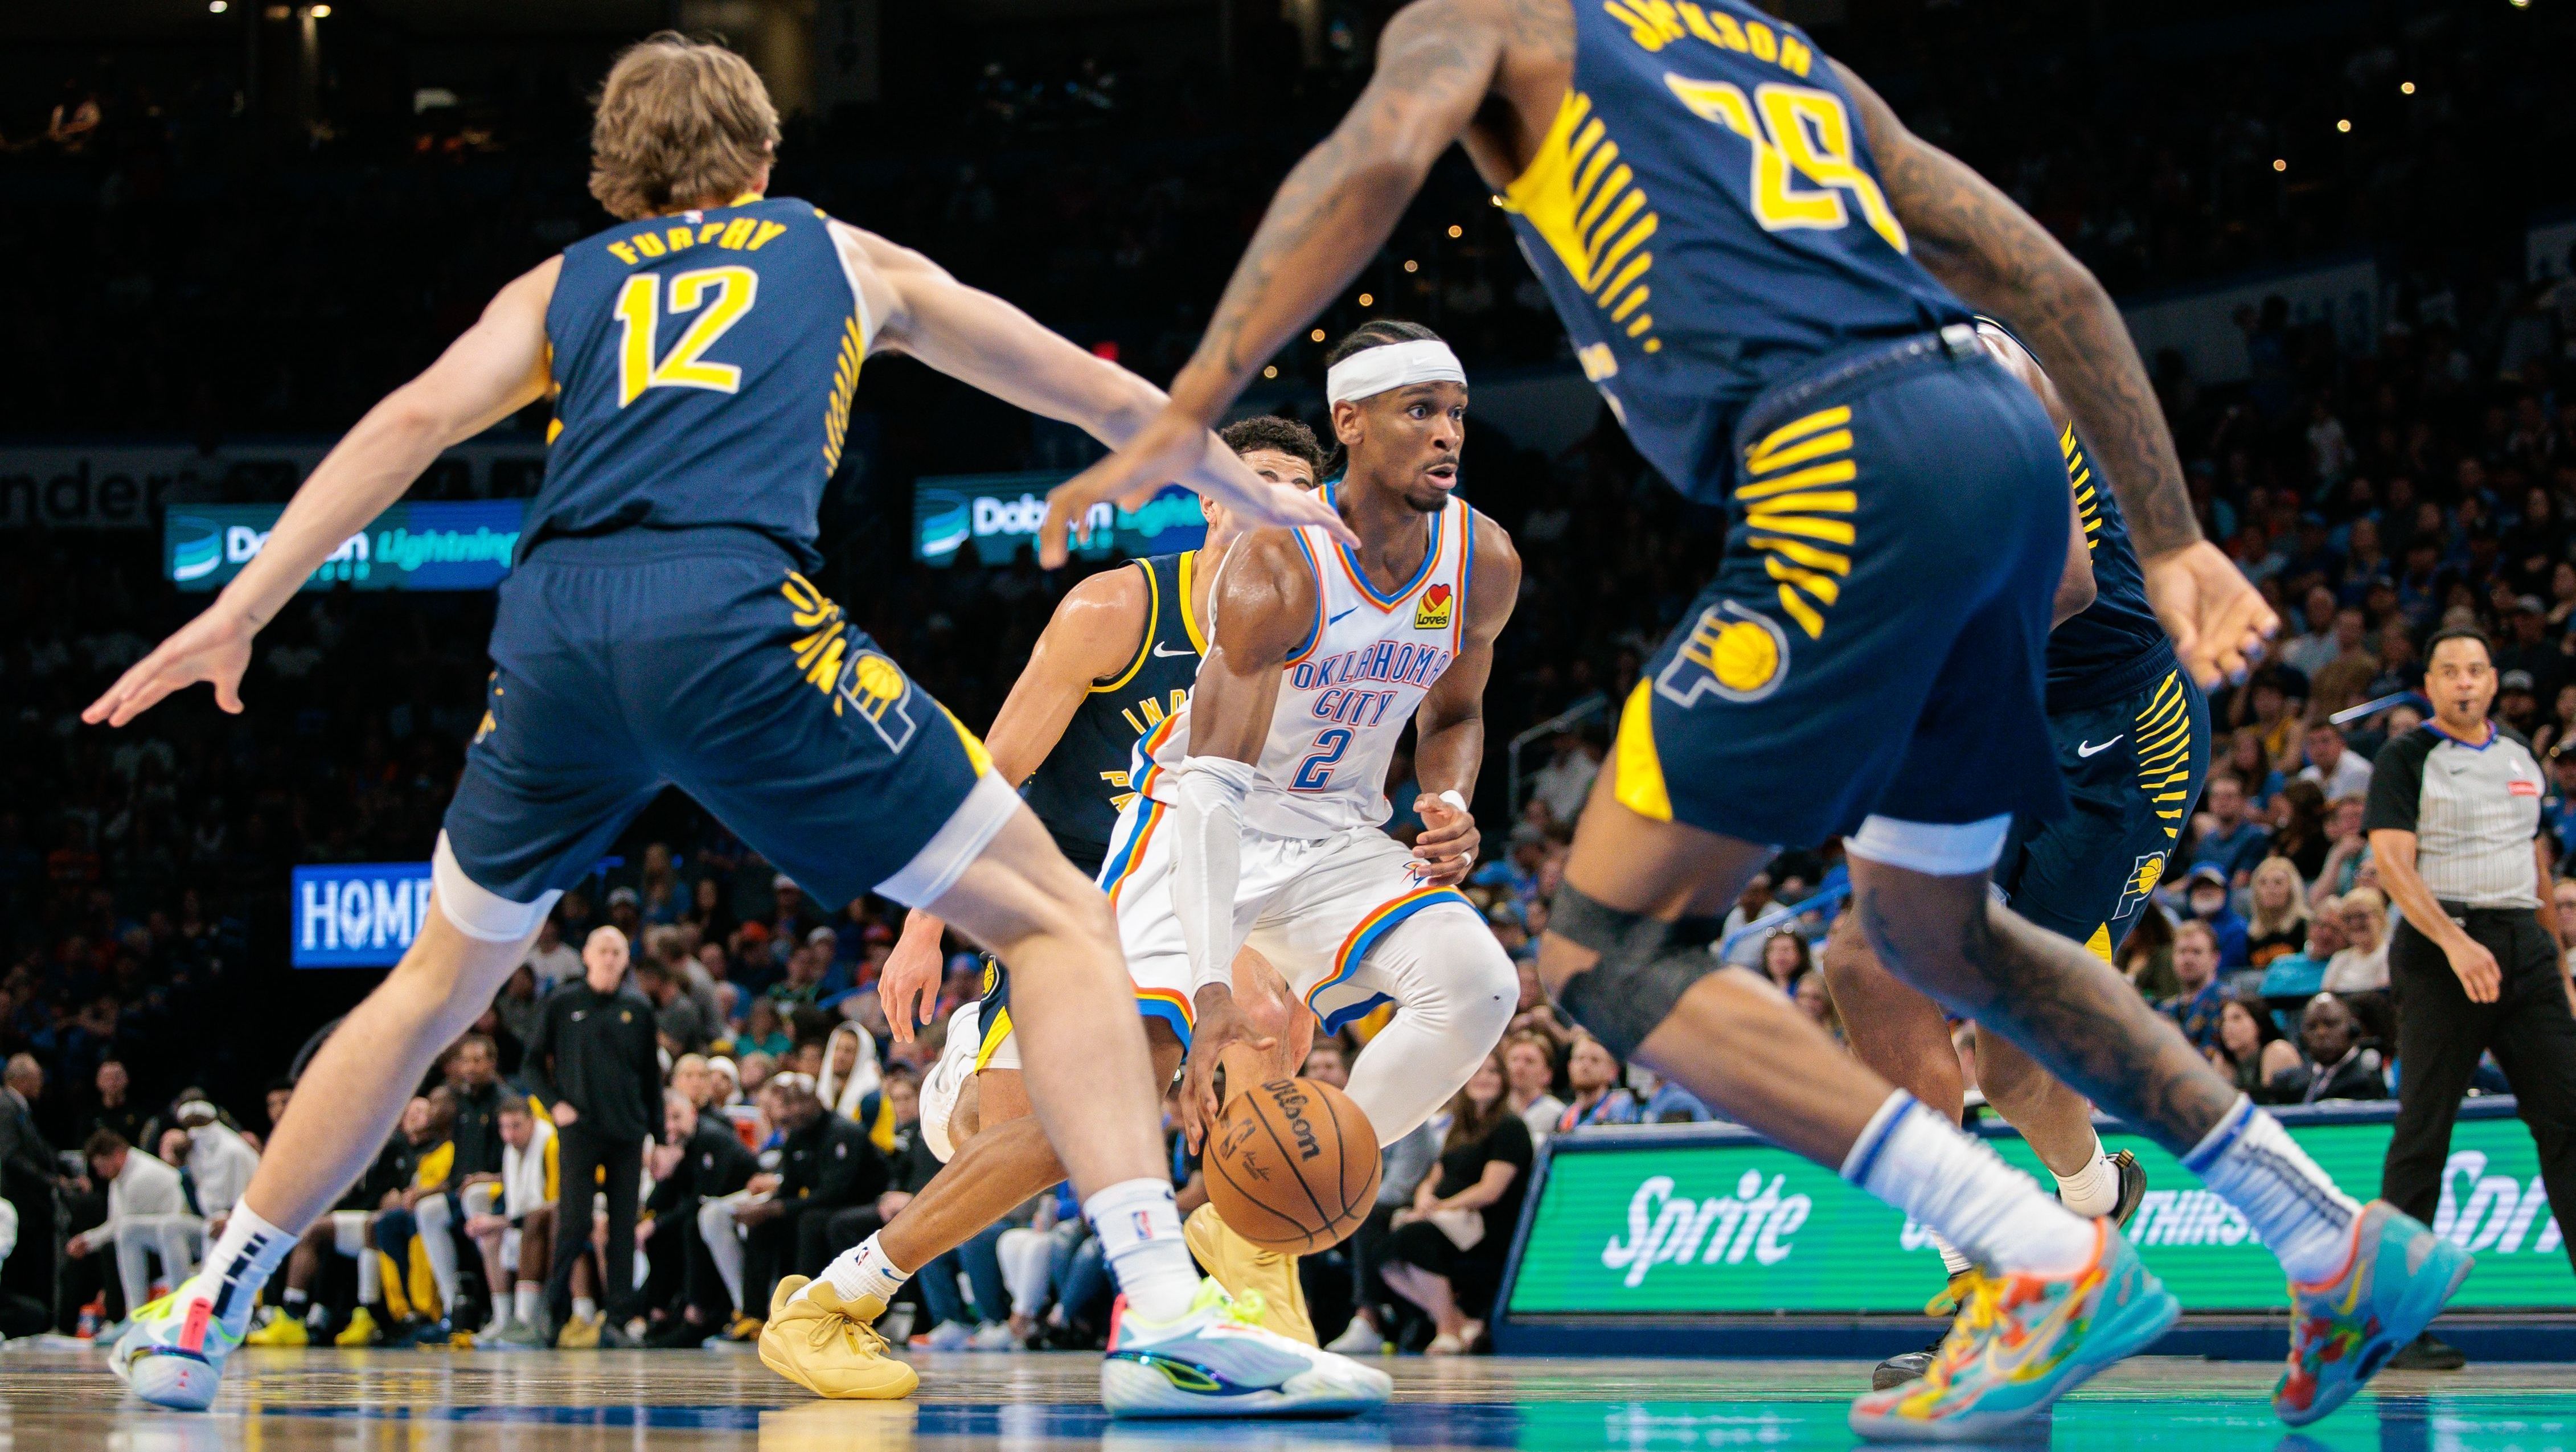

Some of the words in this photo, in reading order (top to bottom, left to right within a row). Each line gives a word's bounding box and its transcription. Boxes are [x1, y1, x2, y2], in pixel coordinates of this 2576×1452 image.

[1664, 72, 1909, 255] 29
[607, 217, 787, 265] FURPHY
[613, 265, 758, 408] 12
[1290, 640, 1449, 691] OKLAHOMA
[1311, 688, 1398, 727] CITY
[1287, 727, 1356, 793] 2
[1601, 1168, 1812, 1288] Sprite
[2127, 1190, 2261, 1246] THIRS
